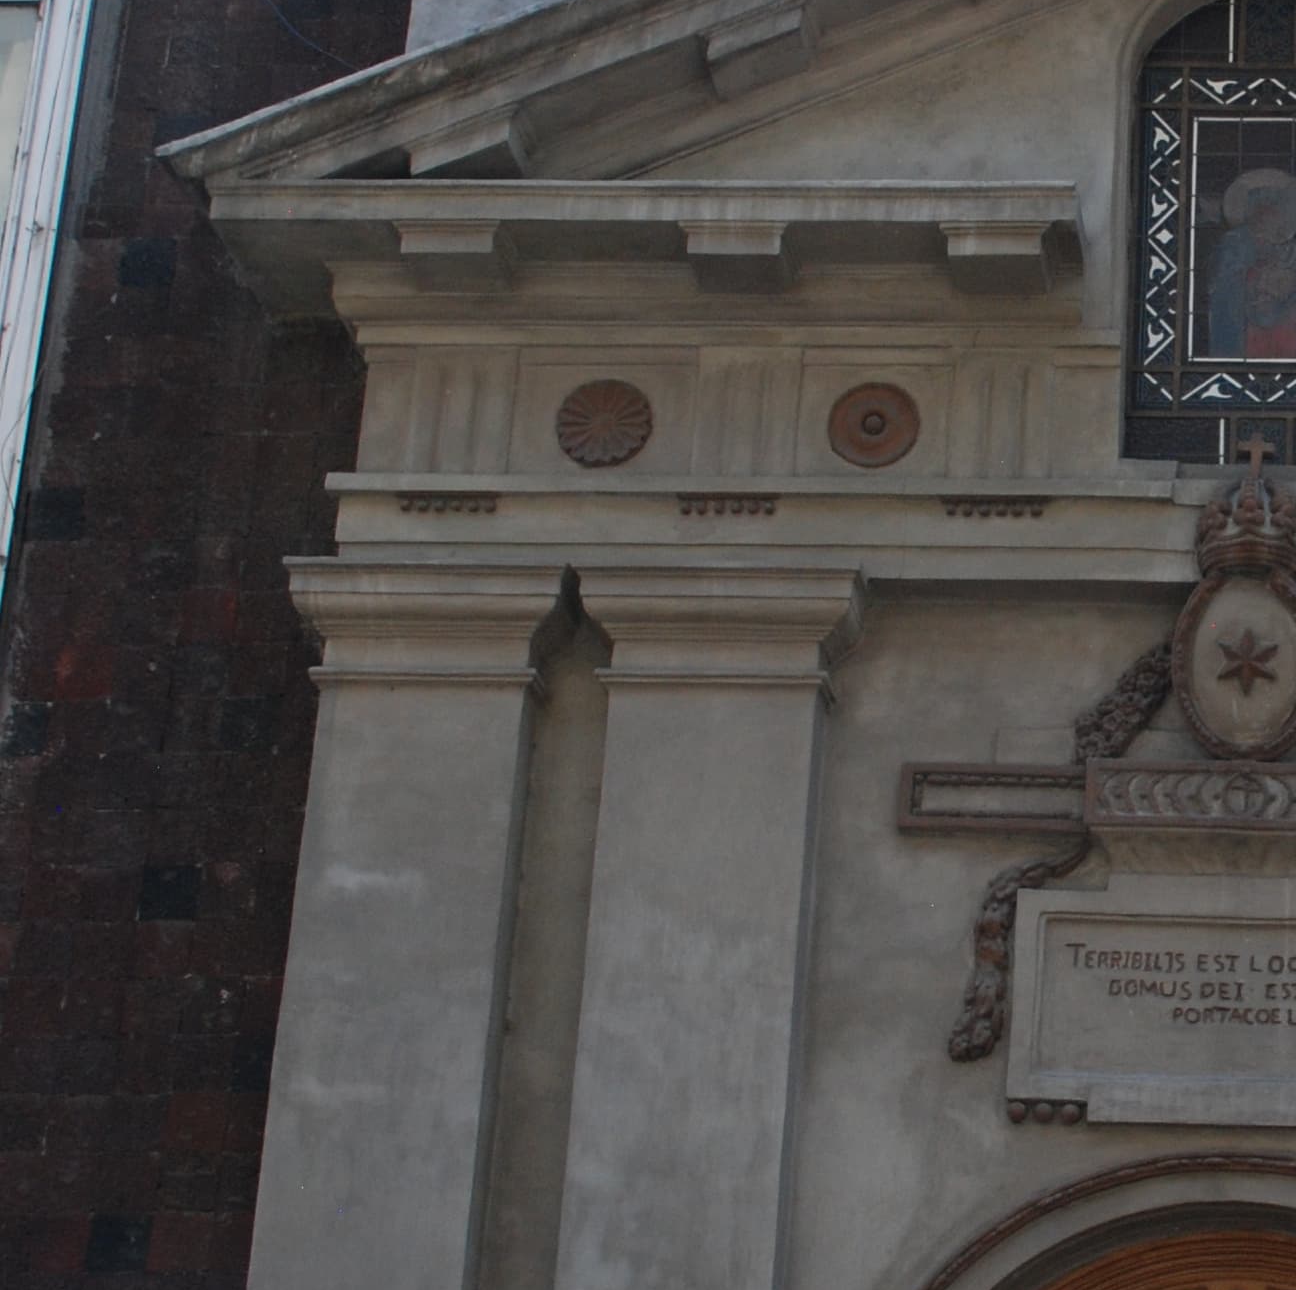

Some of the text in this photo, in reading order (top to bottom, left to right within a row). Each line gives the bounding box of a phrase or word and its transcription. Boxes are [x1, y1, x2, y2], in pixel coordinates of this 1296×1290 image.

[1196, 953, 1240, 973] EST
[1108, 979, 1192, 1001] DOMUS
[1199, 982, 1245, 1001] DEI
